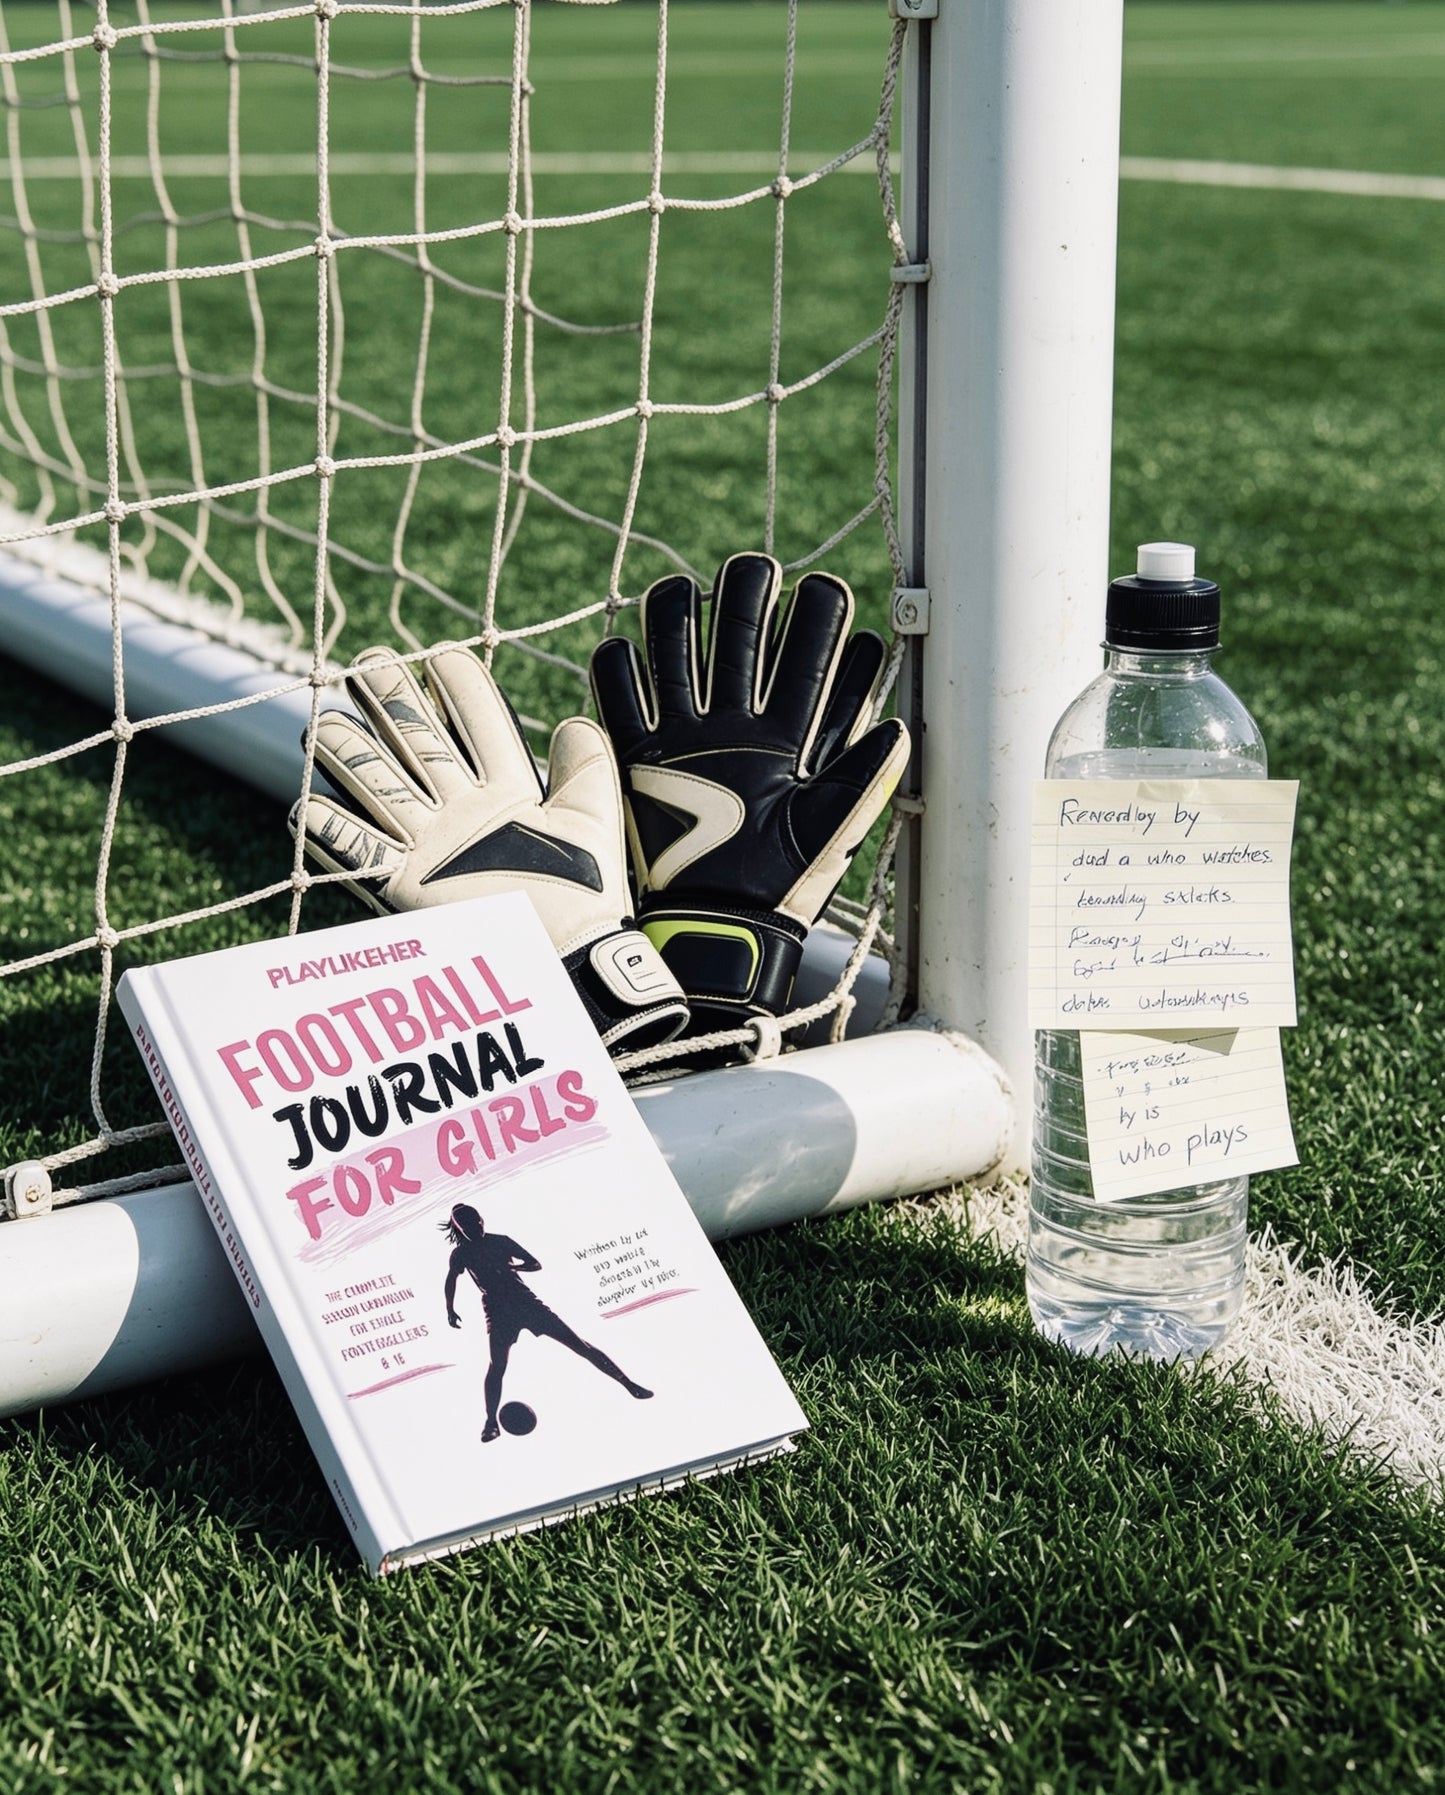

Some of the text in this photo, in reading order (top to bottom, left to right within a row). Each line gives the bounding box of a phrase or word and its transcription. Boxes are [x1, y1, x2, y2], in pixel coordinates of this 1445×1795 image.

[1147, 850, 1186, 866] who
[1174, 802, 1201, 838] by
[216, 955, 533, 1110] FOOTBALL
[272, 1022, 545, 1171] JOURNAL
[1119, 1122, 1248, 1166] who plays
[285, 1070, 599, 1241] FOR GIRLS
